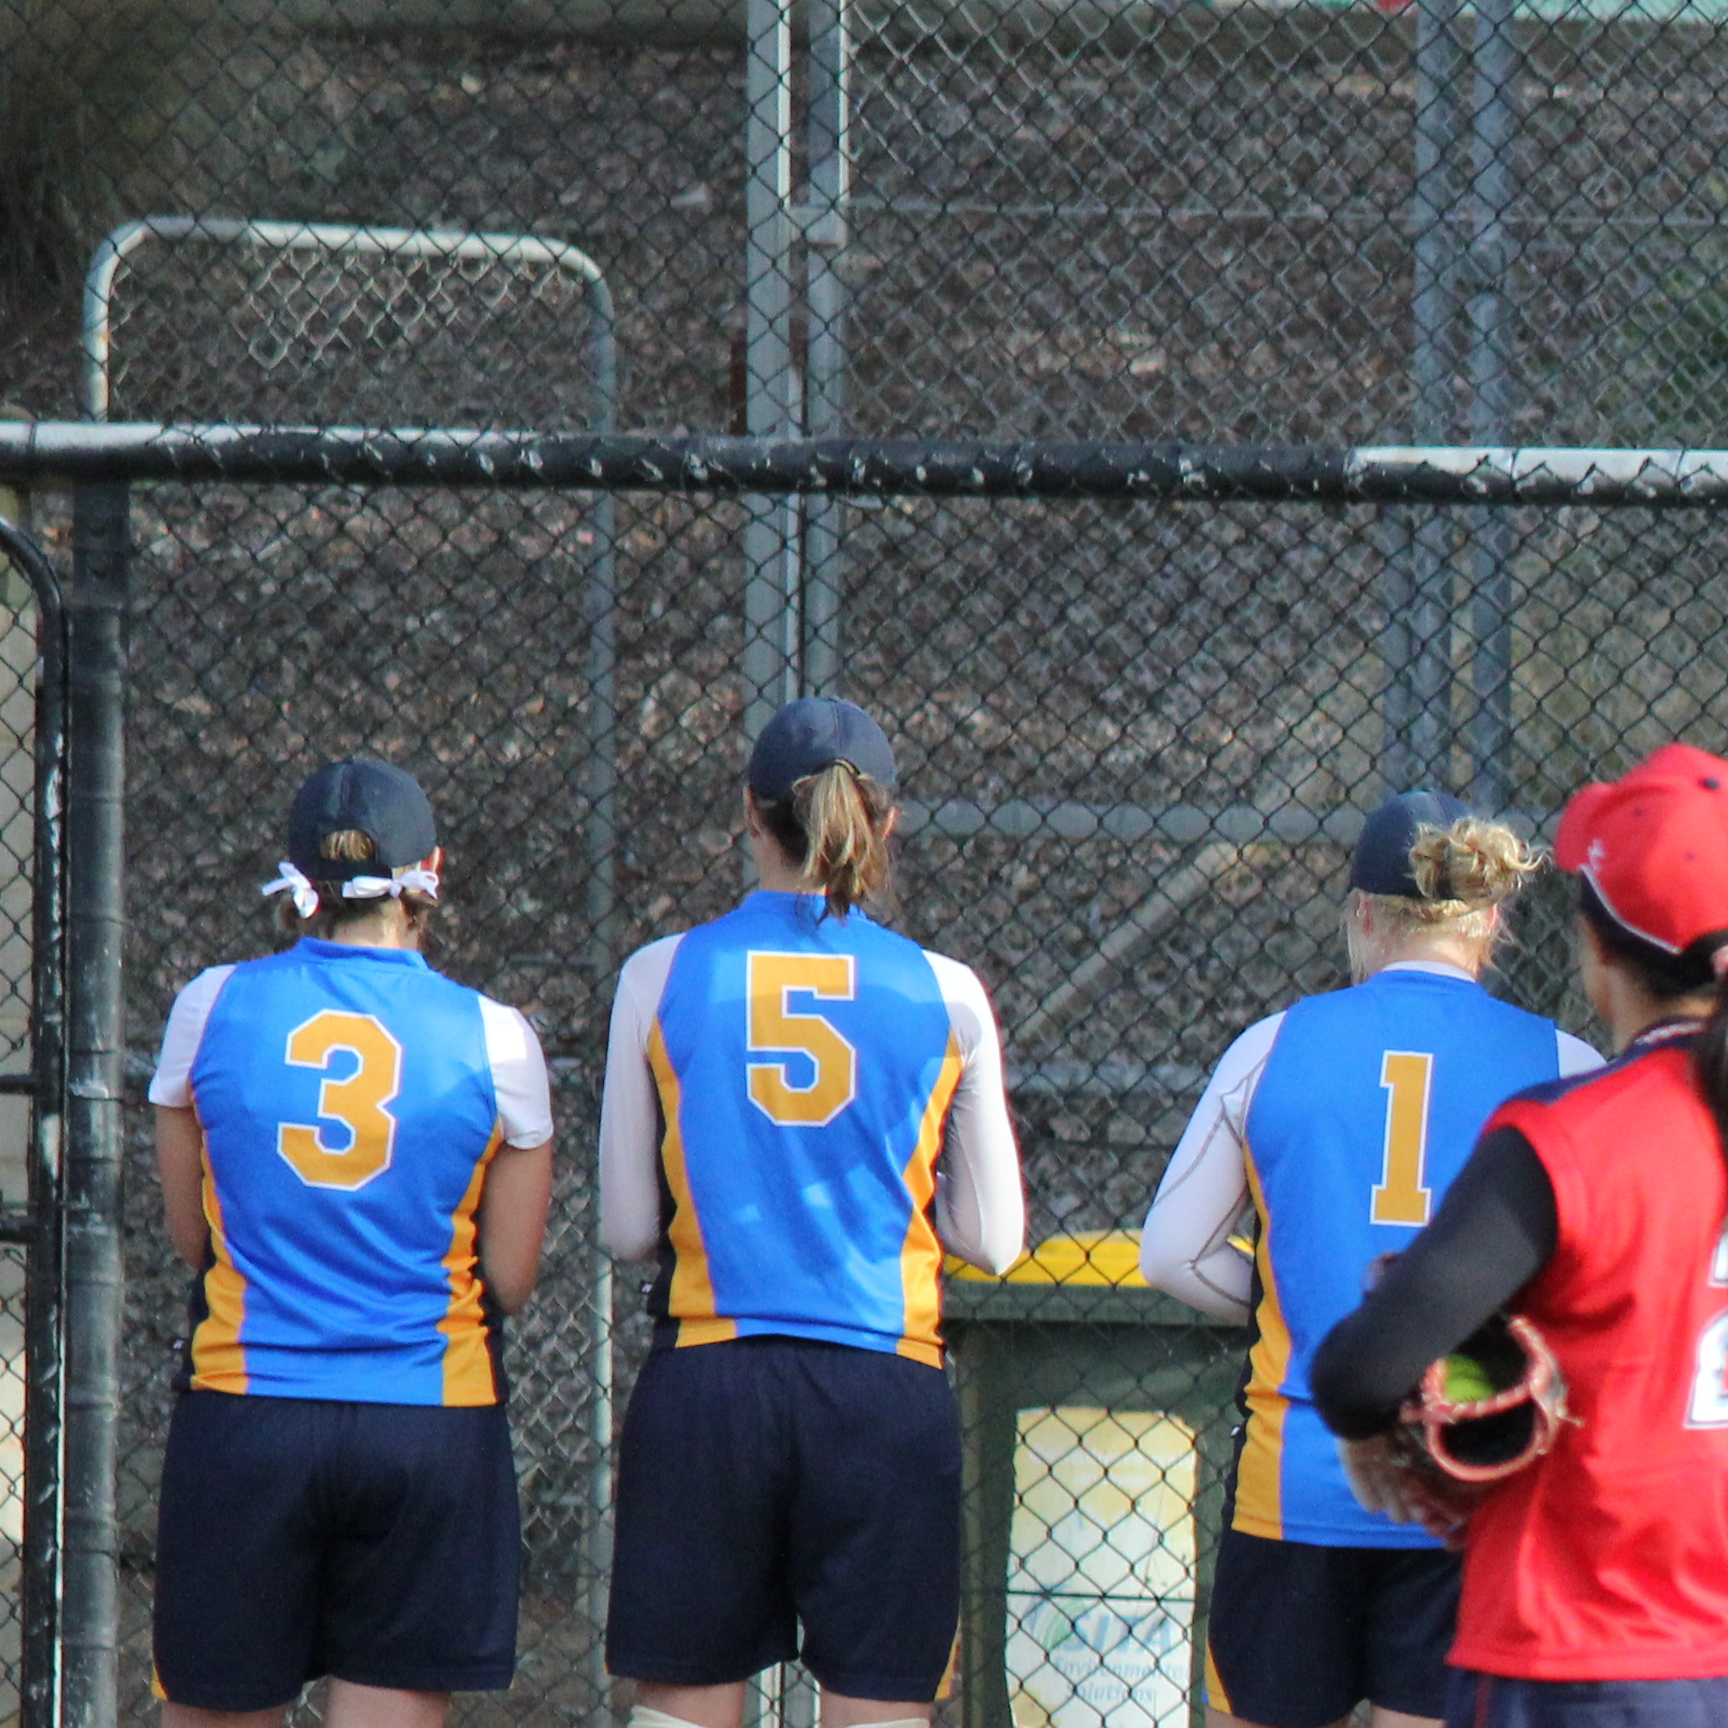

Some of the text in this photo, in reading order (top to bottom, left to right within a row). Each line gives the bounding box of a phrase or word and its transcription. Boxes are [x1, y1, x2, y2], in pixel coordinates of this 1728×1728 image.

[277, 1009, 402, 1191] 3
[745, 950, 857, 1127] 5
[1369, 1050, 1434, 1227] 1
